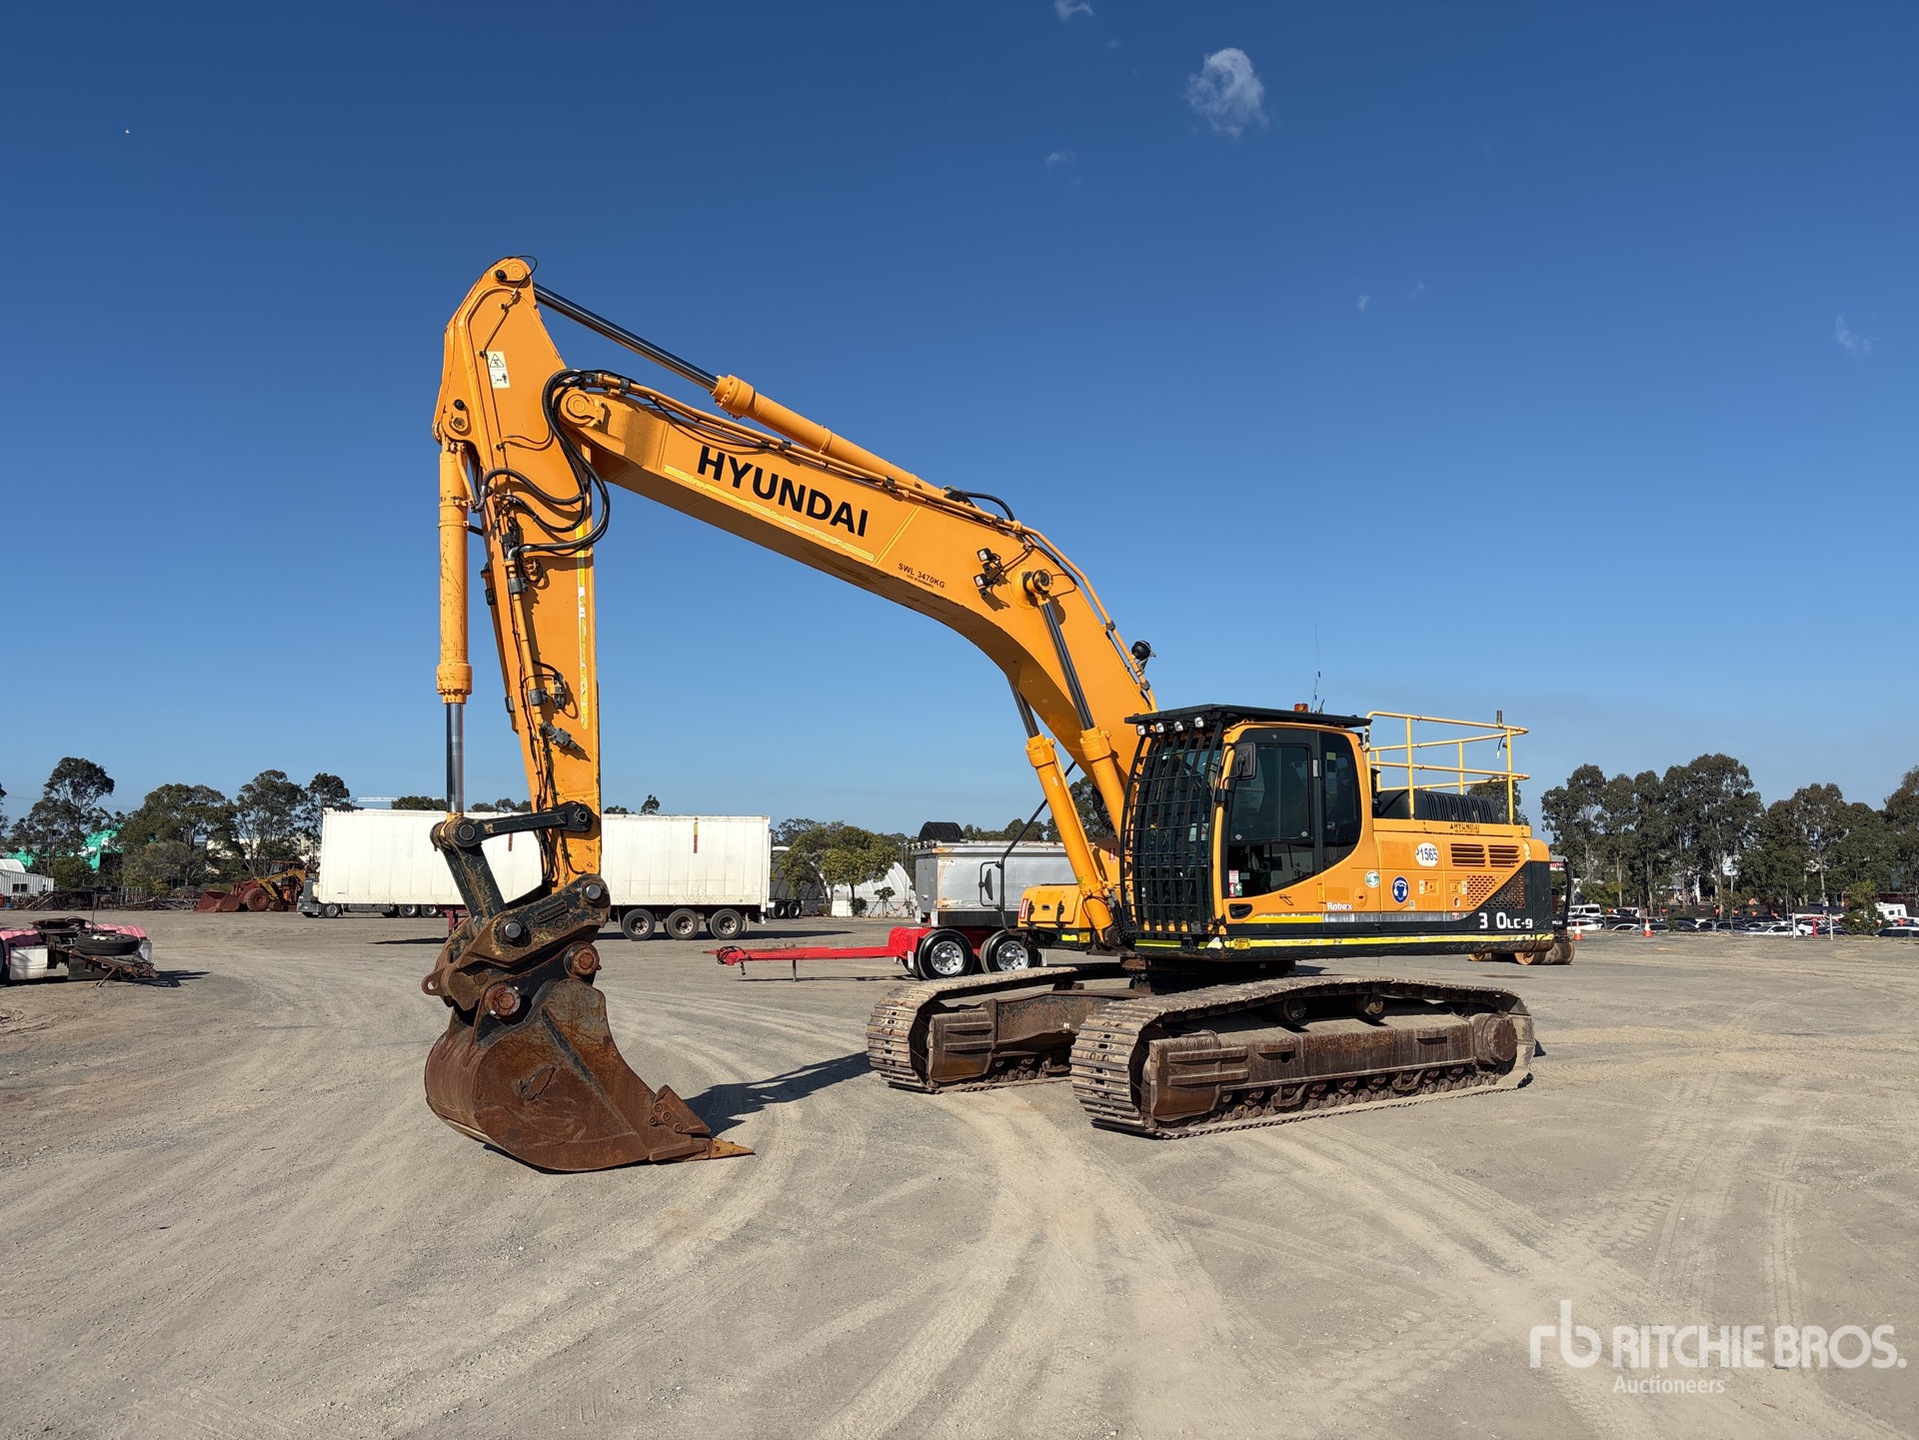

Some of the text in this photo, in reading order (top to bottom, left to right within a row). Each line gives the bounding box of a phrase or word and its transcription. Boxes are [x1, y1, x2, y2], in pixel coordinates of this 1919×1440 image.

[697, 445, 868, 537] HYUNDAI
[898, 562, 915, 576] SWL
[917, 571, 945, 588] 3470KG
